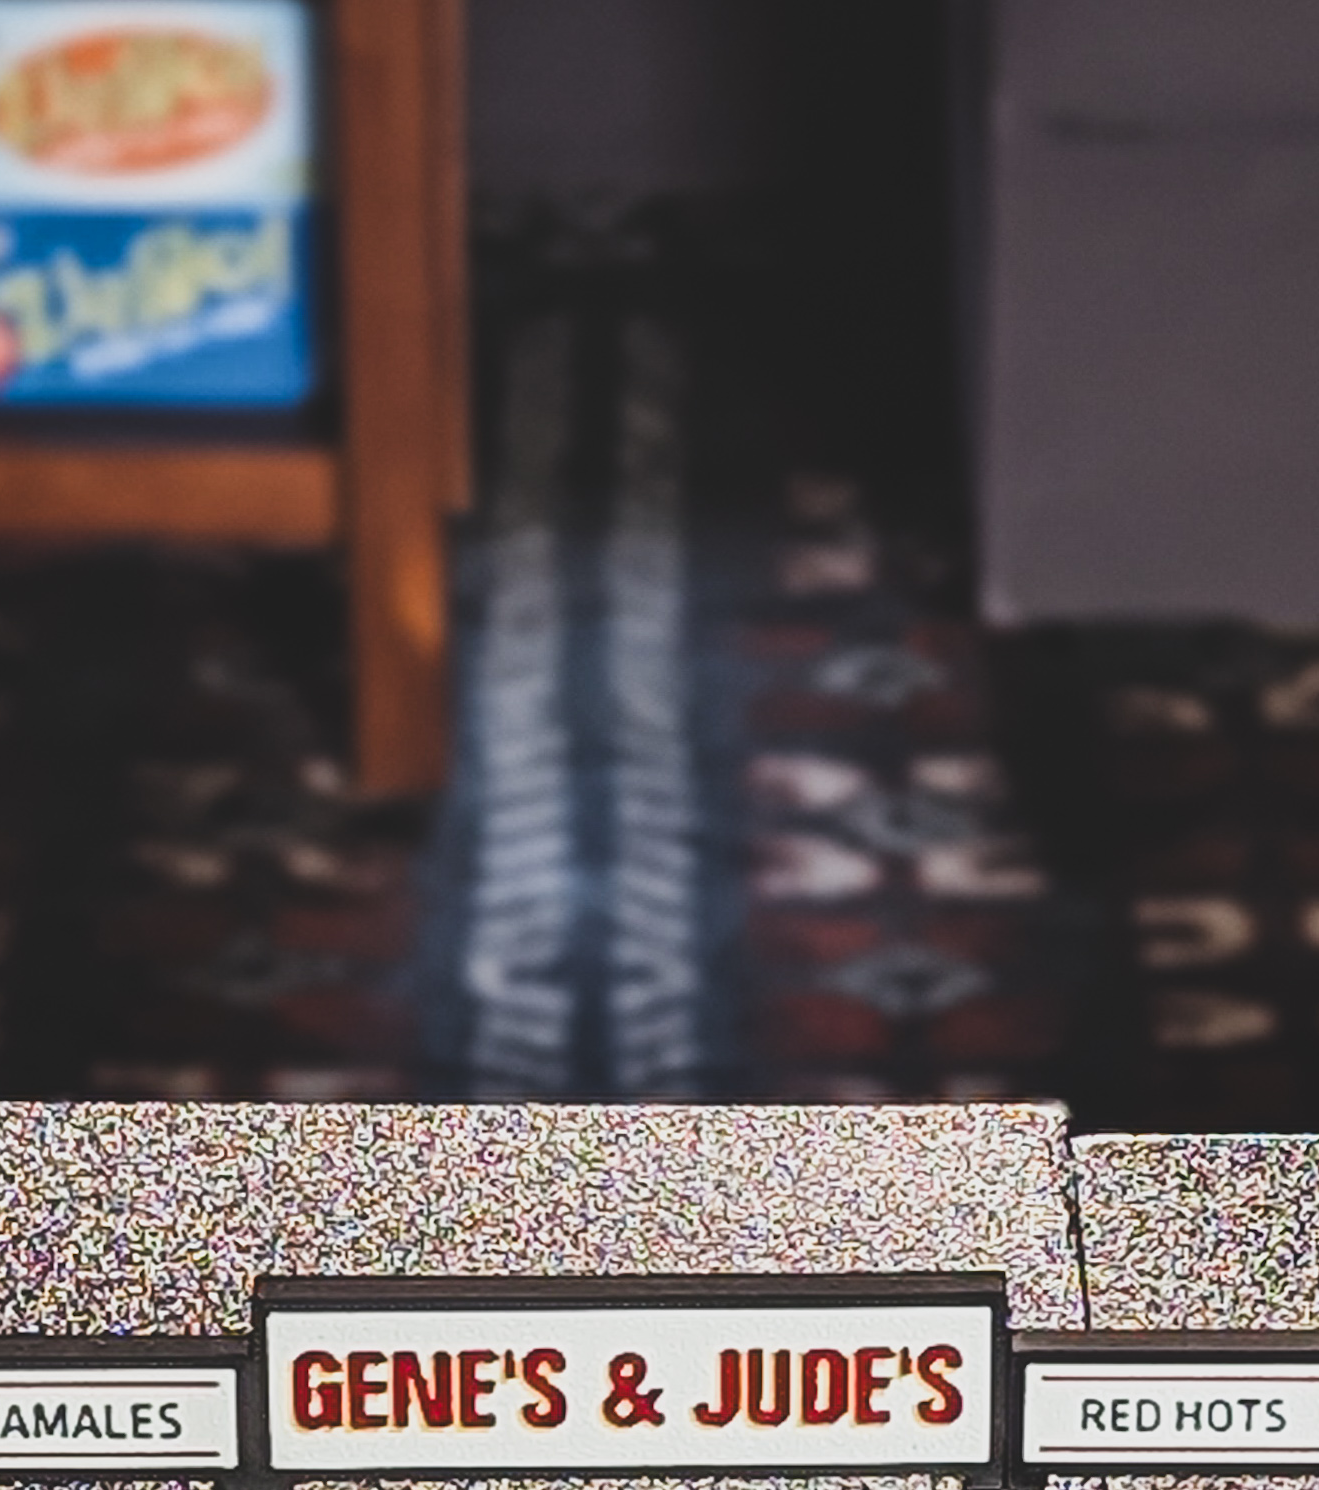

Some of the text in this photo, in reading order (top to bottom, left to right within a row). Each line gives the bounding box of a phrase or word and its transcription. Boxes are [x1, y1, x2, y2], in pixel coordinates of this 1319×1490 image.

[292, 1344, 962, 1431] GENE'S & JUDE'S
[1082, 1399, 1285, 1432] RED HOTS
